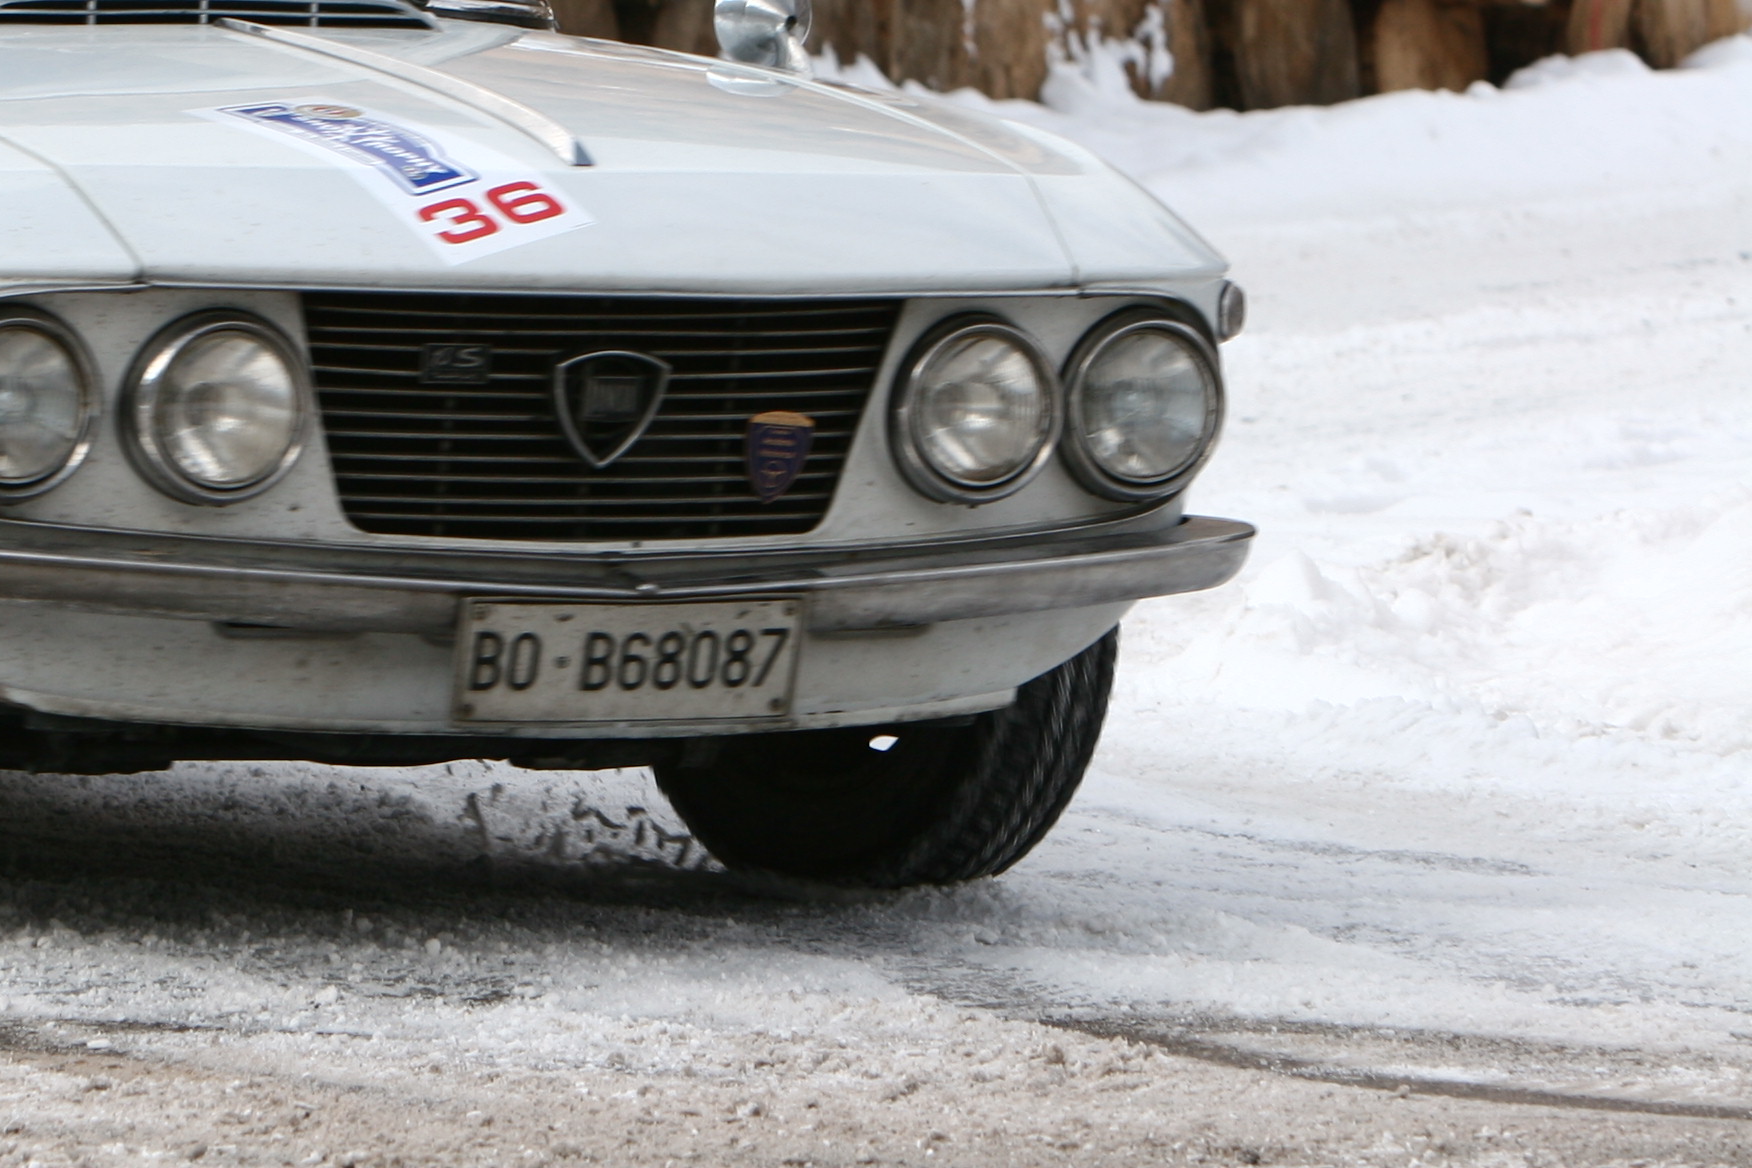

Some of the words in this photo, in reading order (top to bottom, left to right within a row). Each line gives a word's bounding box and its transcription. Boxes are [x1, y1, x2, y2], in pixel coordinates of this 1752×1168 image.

[413, 181, 568, 244] 36
[468, 631, 543, 692] BO
[577, 627, 791, 692] B68087
